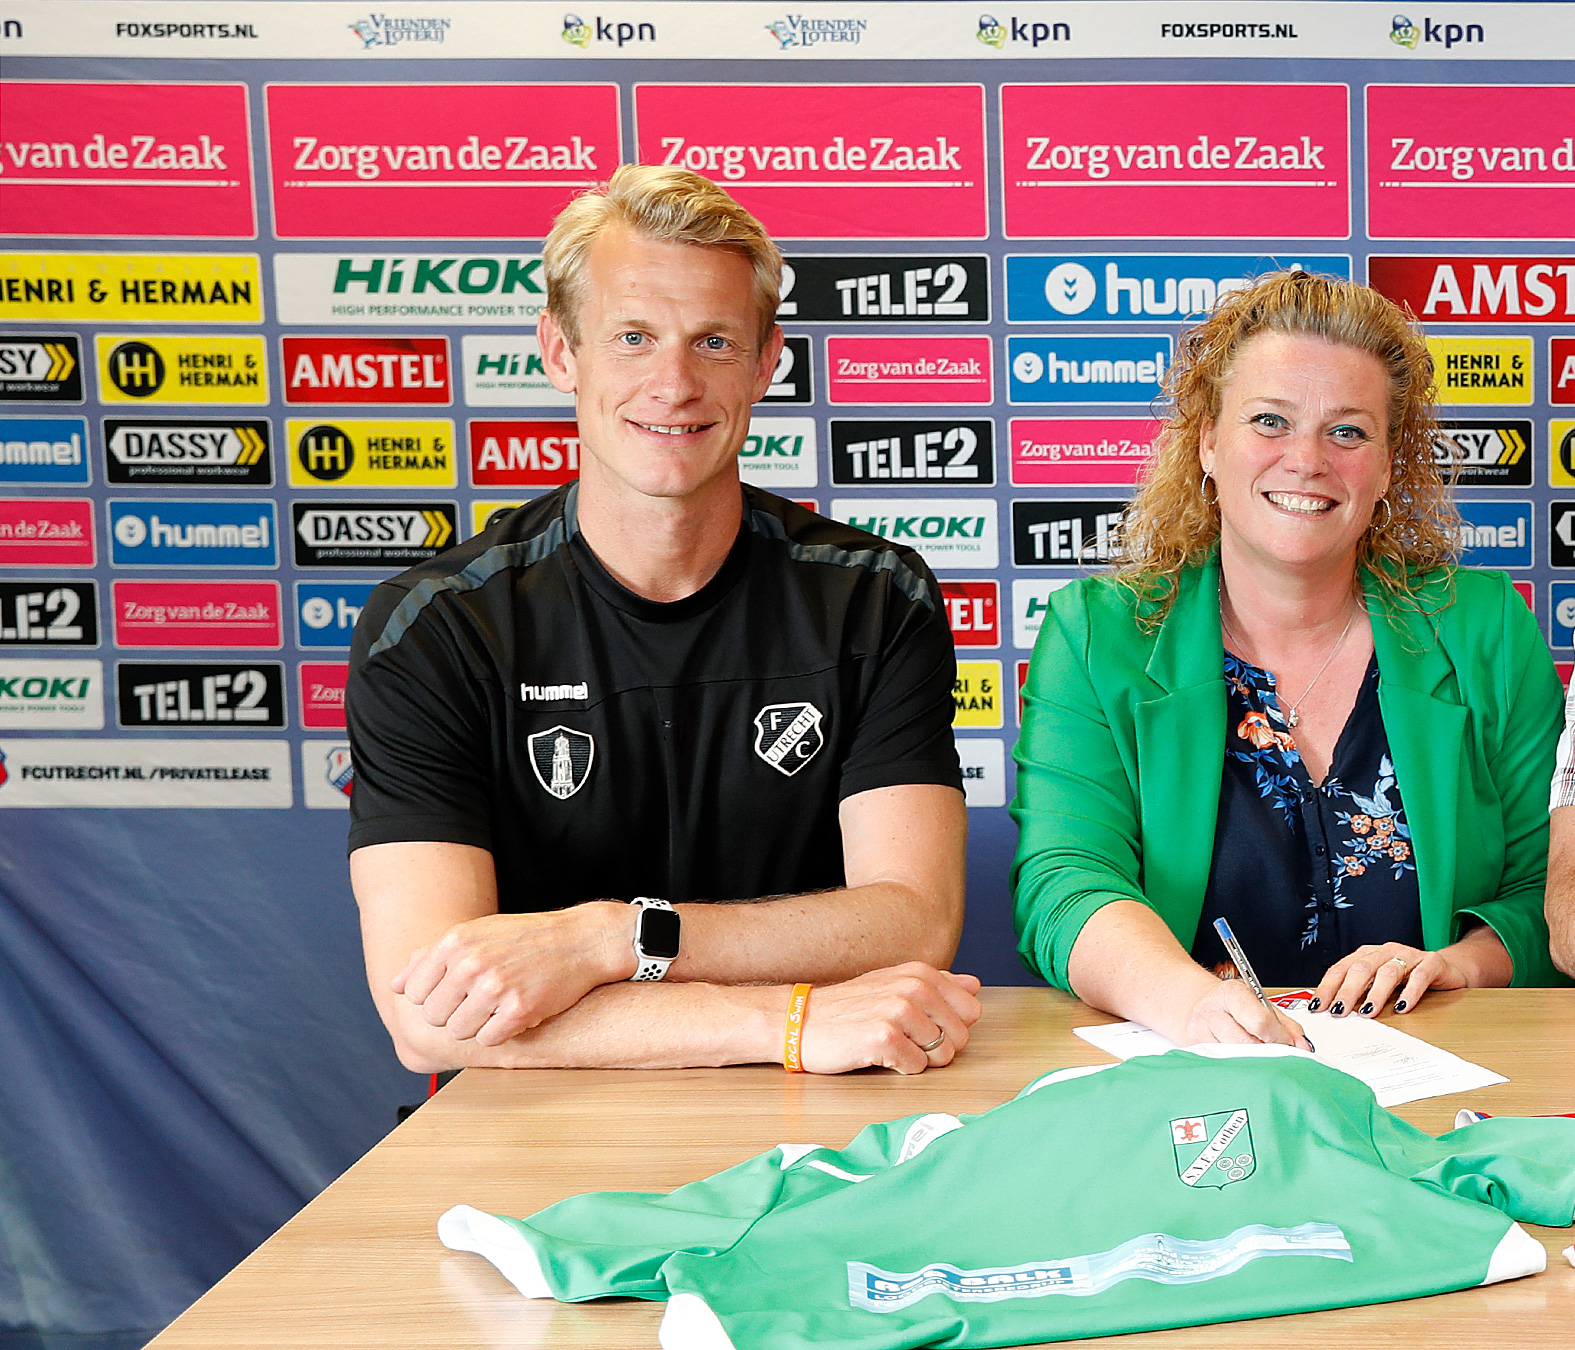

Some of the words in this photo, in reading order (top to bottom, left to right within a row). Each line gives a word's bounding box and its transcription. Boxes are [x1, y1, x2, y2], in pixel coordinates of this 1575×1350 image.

[116, 23, 258, 38] FOXSPORTS.NL
[369, 13, 451, 32] VRIENDEN
[596, 16, 655, 47] kpn
[786, 15, 867, 33] VRIENDEN
[1011, 16, 1071, 48] kpn
[1161, 23, 1298, 38] FOXSPORTS.NL
[1424, 17, 1484, 49] kpn
[381, 28, 444, 46] LOTERIJ
[801, 31, 860, 47] LOTERIJ
[5, 143, 80, 169] van
[83, 134, 128, 169] de
[131, 135, 227, 170] Zaak
[293, 137, 380, 180] Zorg
[386, 145, 463, 170] van
[463, 135, 502, 170] de
[505, 136, 598, 170] Zaak
[658, 137, 746, 181] Zorg
[748, 146, 820, 171] van
[822, 136, 867, 171] de
[870, 136, 962, 171] Zaak
[1026, 137, 1110, 179] Zorg
[1113, 144, 1183, 169] van
[1188, 135, 1231, 169] de
[1234, 136, 1325, 170] Zaak
[1391, 138, 1475, 180] Zorg
[1481, 147, 1547, 171] van
[88, 279, 108, 303] &
[120, 279, 251, 304] HERMAN
[835, 263, 969, 316] TELE2
[331, 305, 365, 316] HIGH
[368, 305, 463, 316] PERFORMANCE
[467, 306, 516, 317] POWER
[178, 354, 232, 369] HENRI
[292, 354, 445, 388] AMSTEL
[837, 358, 880, 381] Zorg
[879, 362, 914, 376] van
[914, 357, 937, 375] de
[937, 358, 981, 375] Zaak
[1049, 353, 1164, 384] hummel
[1446, 354, 1500, 370] HENRI
[180, 372, 258, 387] HERMAN
[1447, 372, 1524, 388] HERMAN
[124, 432, 228, 459] DASSY
[367, 437, 421, 452] HENRI
[477, 437, 579, 471] AMST
[846, 427, 979, 479] TELE2
[369, 455, 446, 470] HERMAN
[150, 515, 270, 548] hummel
[315, 515, 416, 541] DASSY
[845, 516, 985, 542] HiKOKI
[133, 670, 270, 721] TELE2
[520, 681, 589, 702] hummel
[770, 712, 782, 731] F
[767, 708, 816, 762] UTRECHT
[795, 741, 810, 758] C
[21, 766, 145, 780] FCUTRECHT.NL
[149, 768, 269, 780] /PRIVATELEASE
